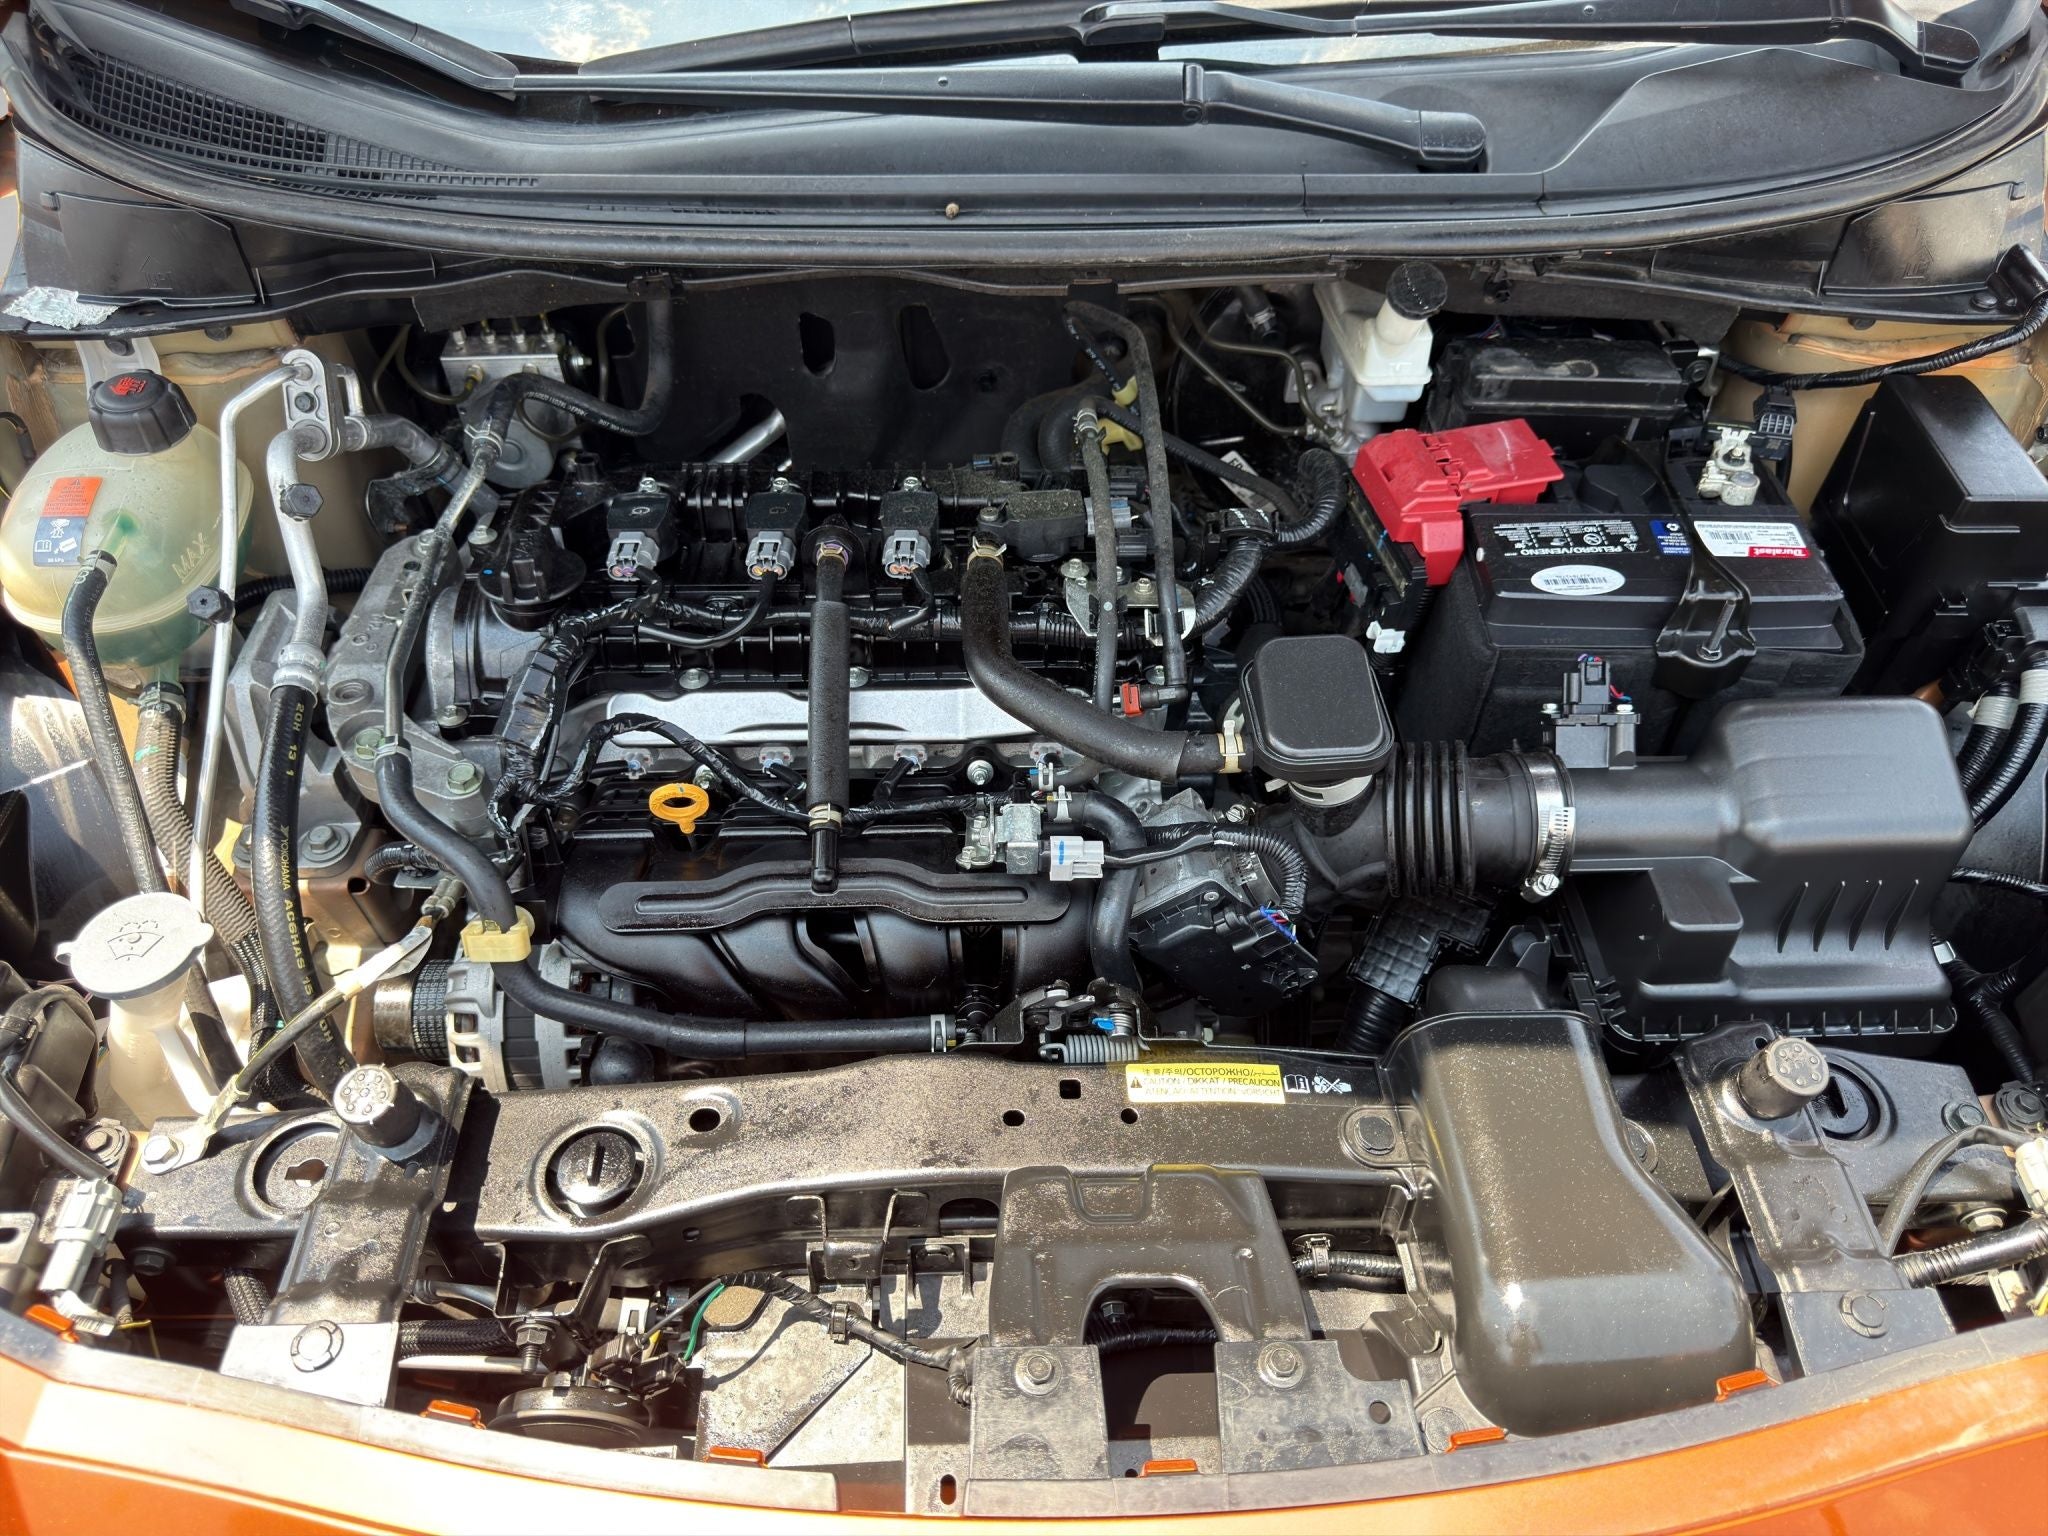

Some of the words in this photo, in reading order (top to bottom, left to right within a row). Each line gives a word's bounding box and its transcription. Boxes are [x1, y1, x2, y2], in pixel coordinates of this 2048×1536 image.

[1520, 544, 1623, 556] PELIGRO/VENENO
[1753, 547, 1807, 557] Duralast
[109, 742, 127, 778] NISSAN
[280, 838, 291, 891] YOKOHAMA
[1187, 1077, 1220, 1085] DIKKAT
